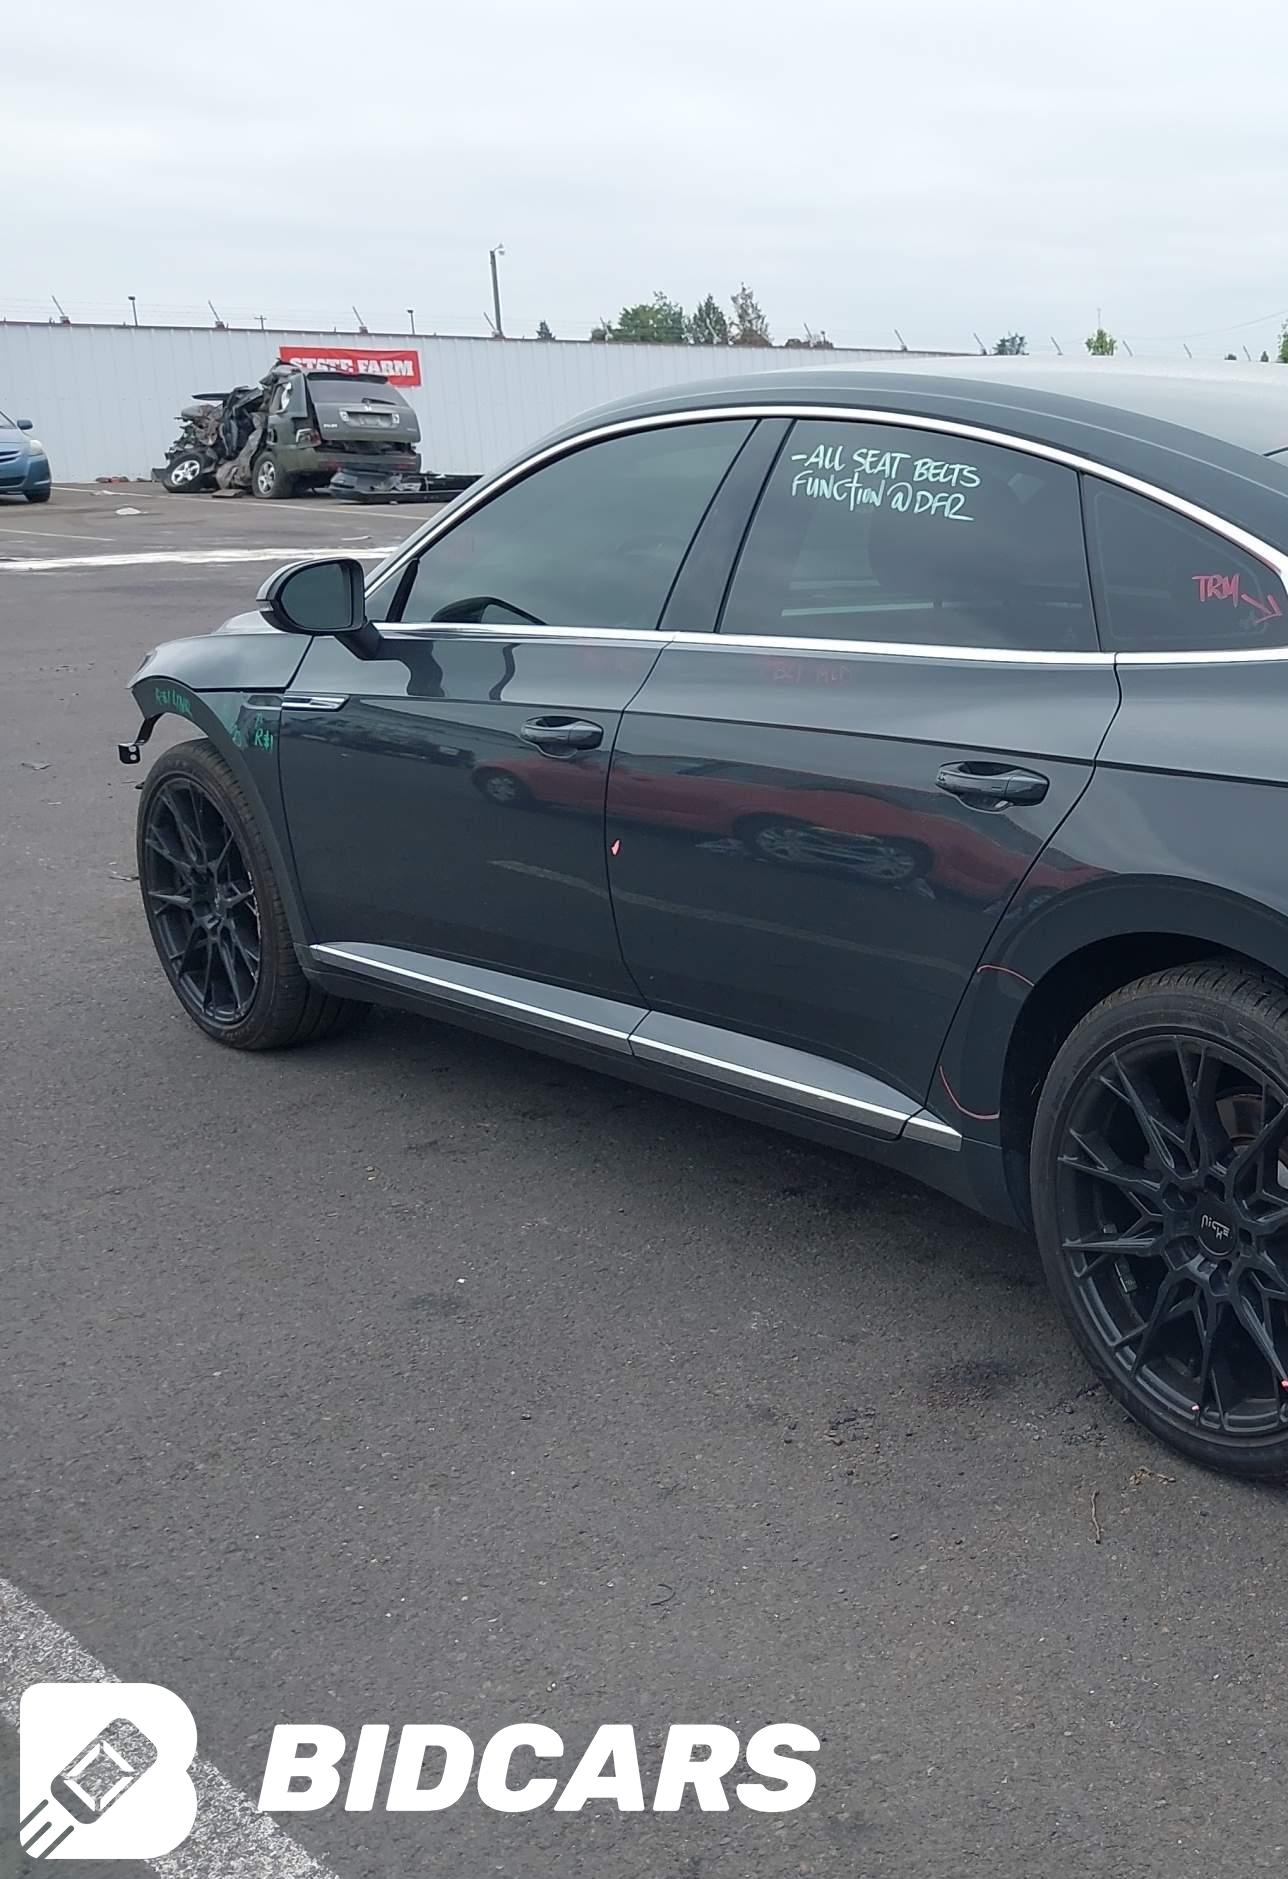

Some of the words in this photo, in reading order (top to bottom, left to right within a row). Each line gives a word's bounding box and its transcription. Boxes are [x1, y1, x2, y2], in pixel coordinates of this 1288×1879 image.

[357, 359, 414, 376] FARM
[852, 448, 911, 479] SEAT
[913, 458, 981, 487] BELTS
